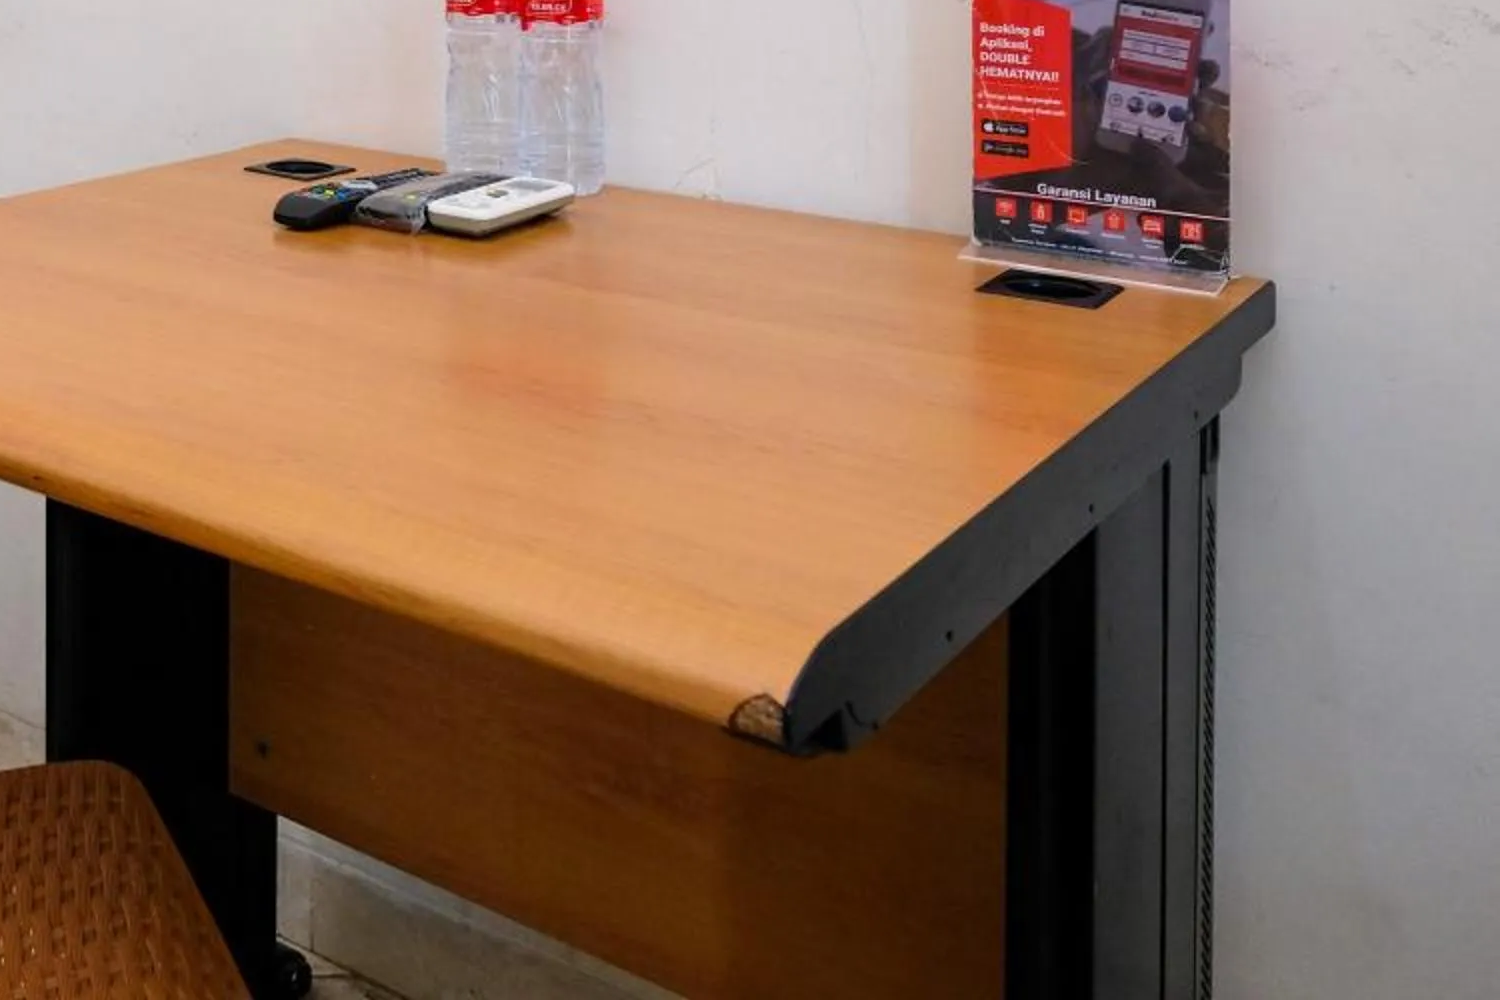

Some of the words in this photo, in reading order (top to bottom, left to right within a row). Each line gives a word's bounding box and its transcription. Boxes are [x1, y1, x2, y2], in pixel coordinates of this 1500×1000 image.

[979, 22, 1030, 38] Booking
[1033, 25, 1045, 37] di
[979, 51, 1031, 65] DOUBLE
[1037, 183, 1091, 200] Garansi
[1095, 190, 1157, 209] Layanan
